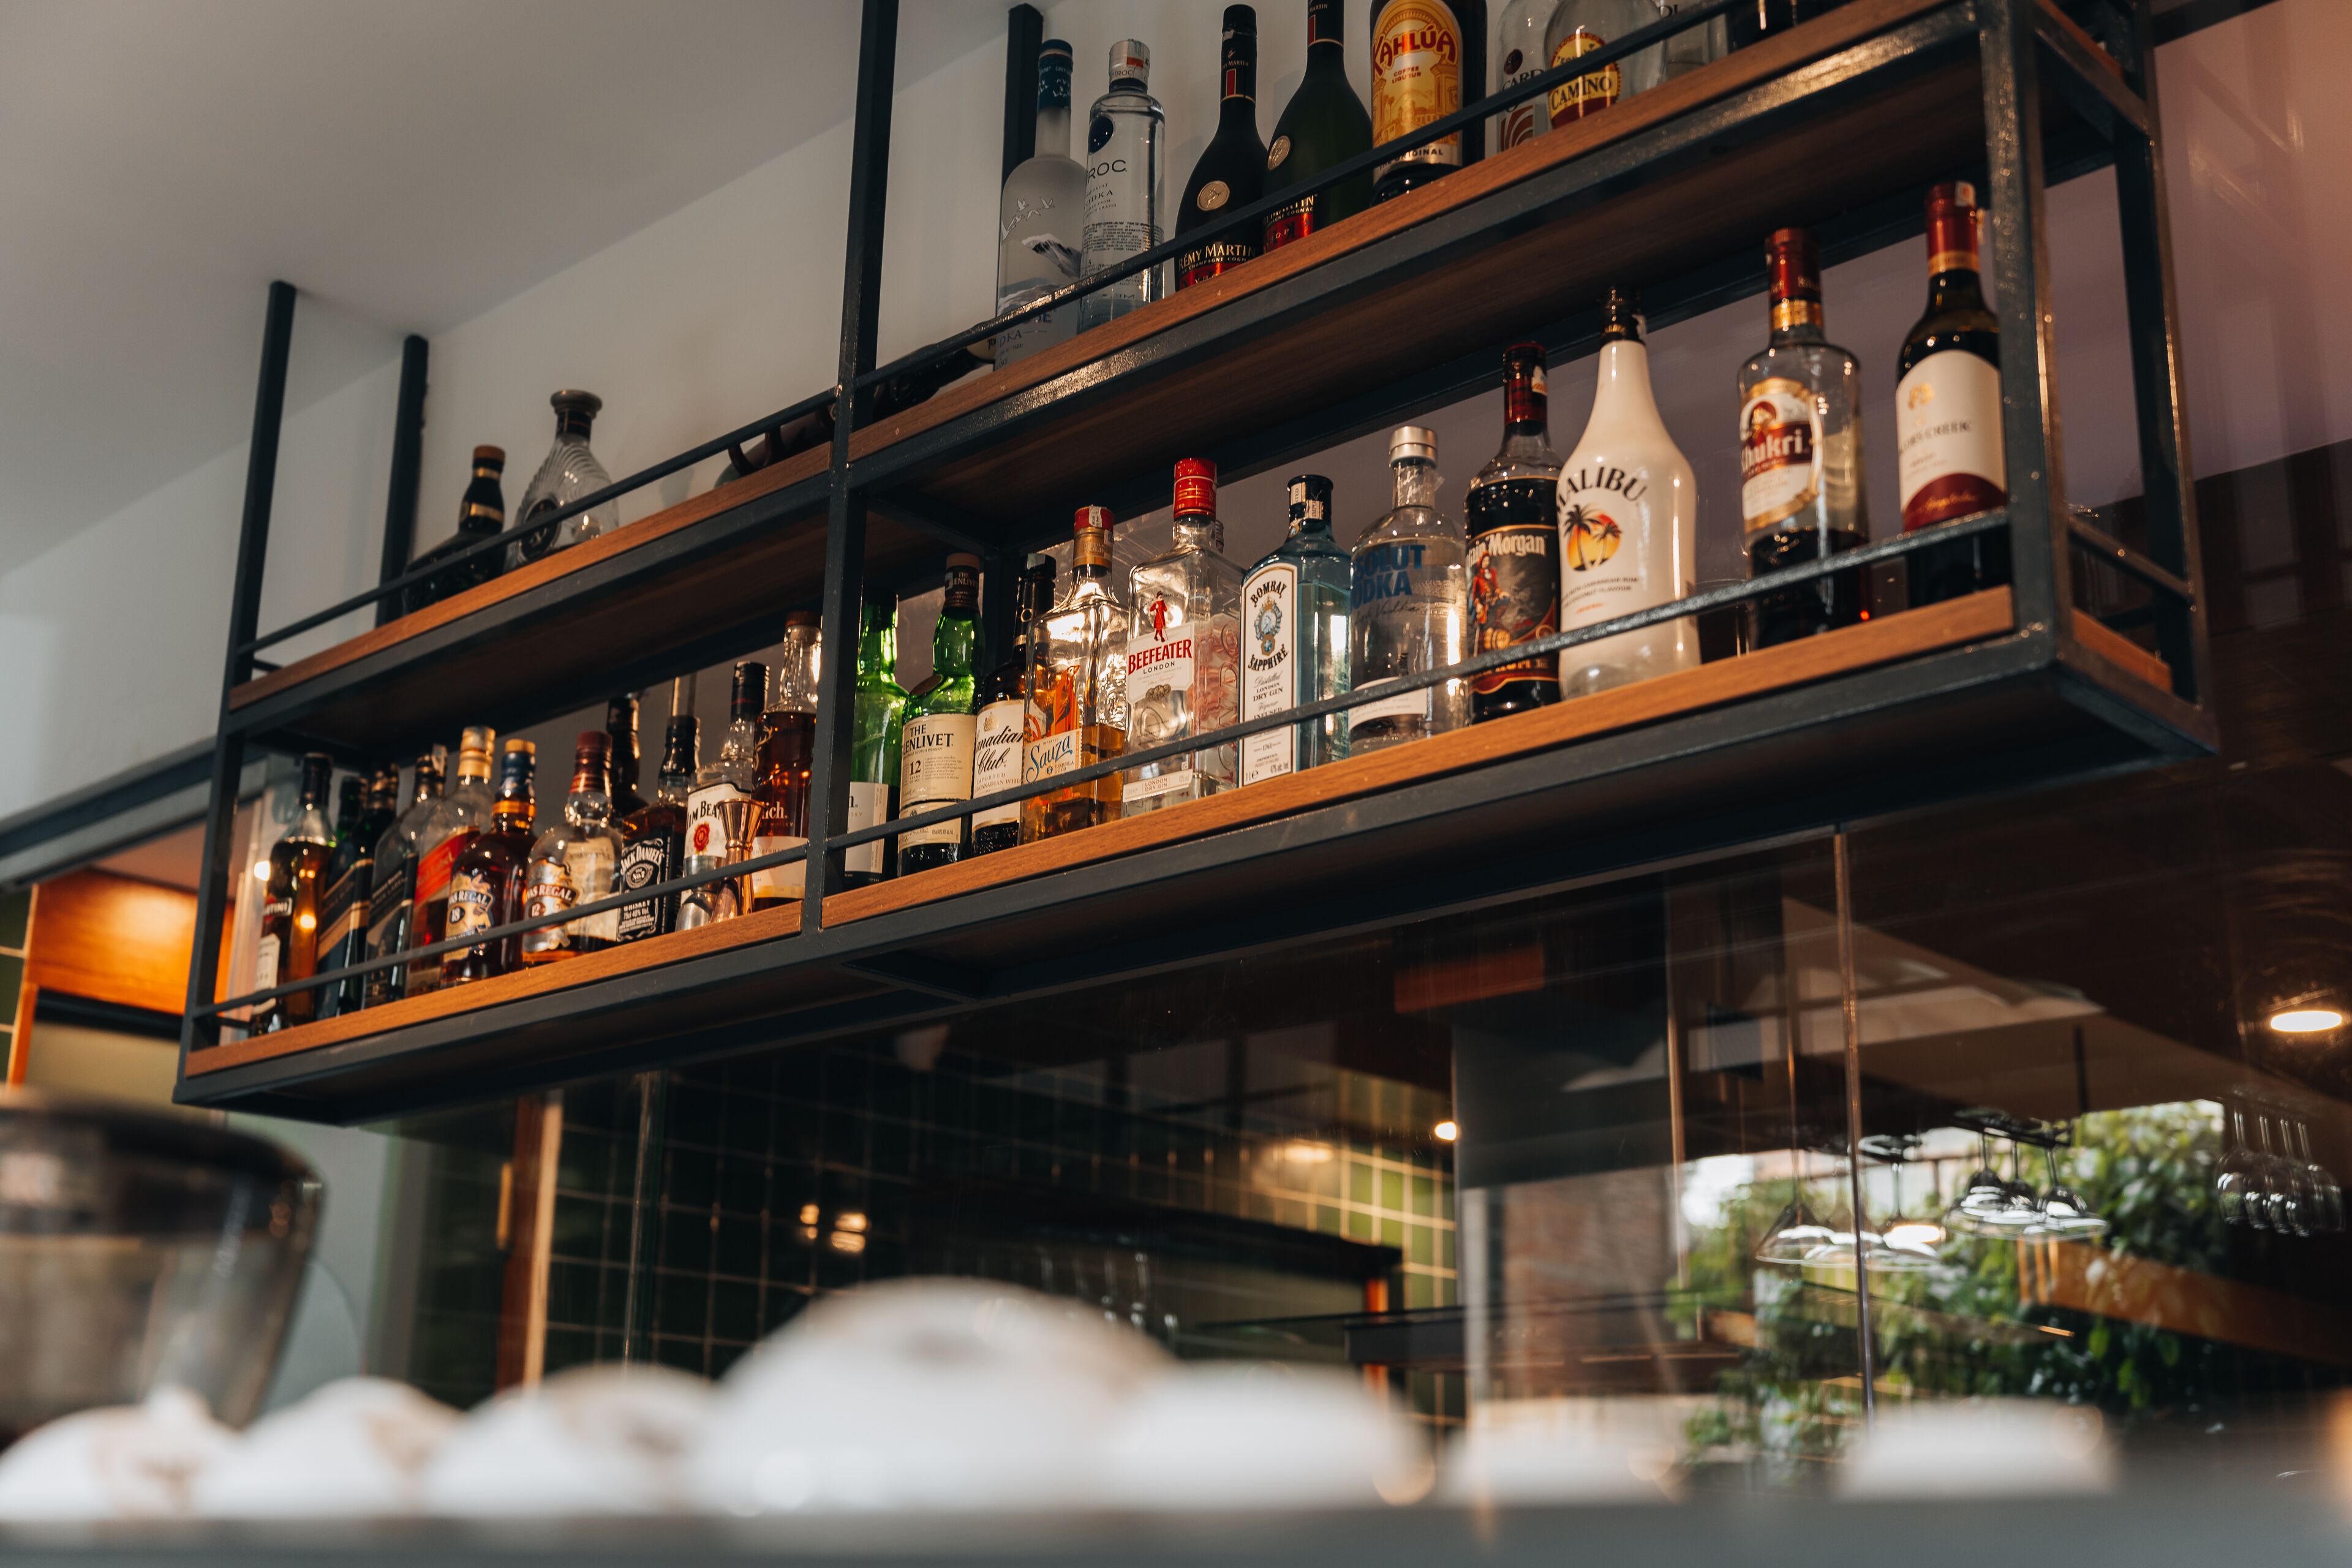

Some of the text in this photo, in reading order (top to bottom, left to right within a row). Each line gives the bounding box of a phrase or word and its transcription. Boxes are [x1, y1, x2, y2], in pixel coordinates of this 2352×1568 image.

[1371, 25, 1457, 82] KAHLÚA
[1393, 66, 1420, 77] COFFEE
[1088, 160, 1126, 184] ROC
[1086, 190, 1113, 206] ODKA
[1179, 243, 1256, 271] RÉMY MARTIN
[1488, 532, 1546, 557] Morgan
[1355, 545, 1426, 582] SOLUT
[1250, 581, 1287, 608] BOMBAY
[1351, 571, 1412, 613] ODKA
[1128, 639, 1193, 676] BEEFEATER
[1248, 644, 1289, 671] SAPPHIRE
[1143, 661, 1175, 674] LONDON
[1253, 687, 1283, 702] DRY GIN
[1256, 682, 1280, 693] LONDON
[910, 724, 927, 737] THE
[910, 760, 921, 776] 12
[978, 748, 1011, 775] Club
[1026, 735, 1073, 784] Sauza
[1145, 777, 1167, 787] LONDON
[700, 801, 720, 820] BEA
[620, 851, 636, 875] JACK
[459, 891, 488, 906] REGAL
[539, 884, 573, 901] REGAL
[451, 907, 461, 922] 18
[532, 903, 540, 918] 12
